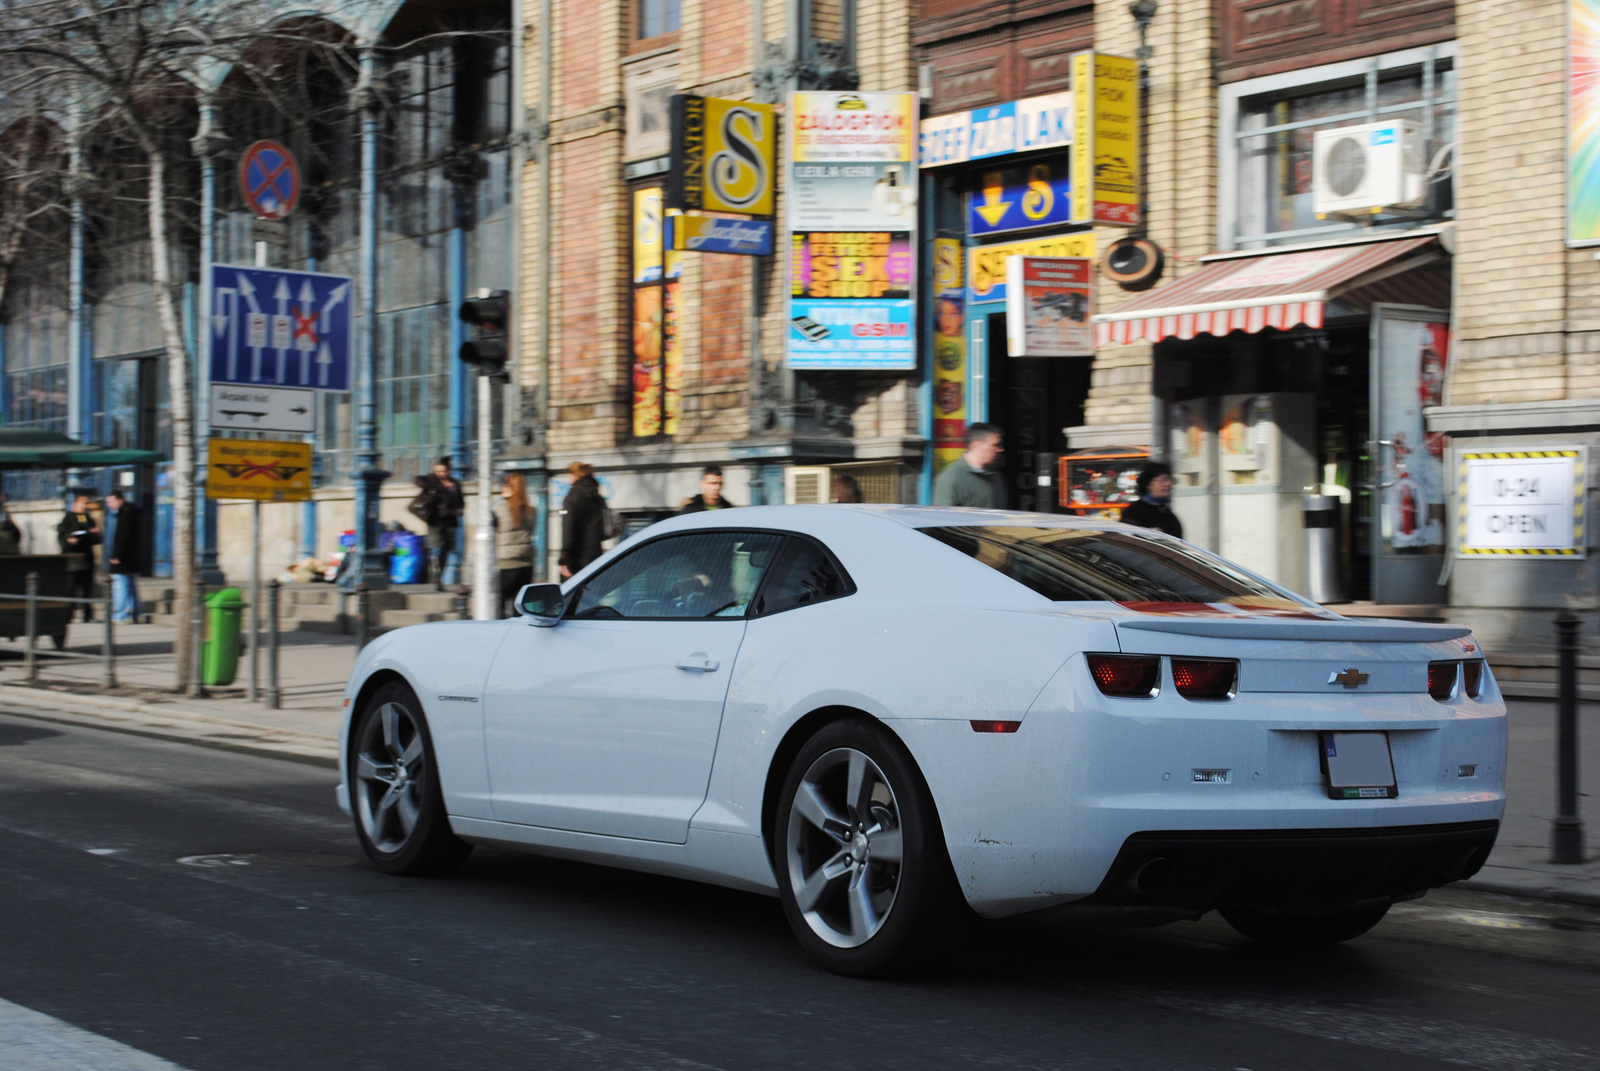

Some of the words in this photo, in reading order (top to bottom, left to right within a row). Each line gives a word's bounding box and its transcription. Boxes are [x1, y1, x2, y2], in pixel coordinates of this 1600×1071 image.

[706, 106, 766, 208] S
[809, 256, 889, 282] SEX
[808, 281, 892, 298] SHOP
[852, 323, 908, 337] GSM
[1492, 478, 1540, 497] 0-24
[1485, 514, 1548, 533] OPEN
